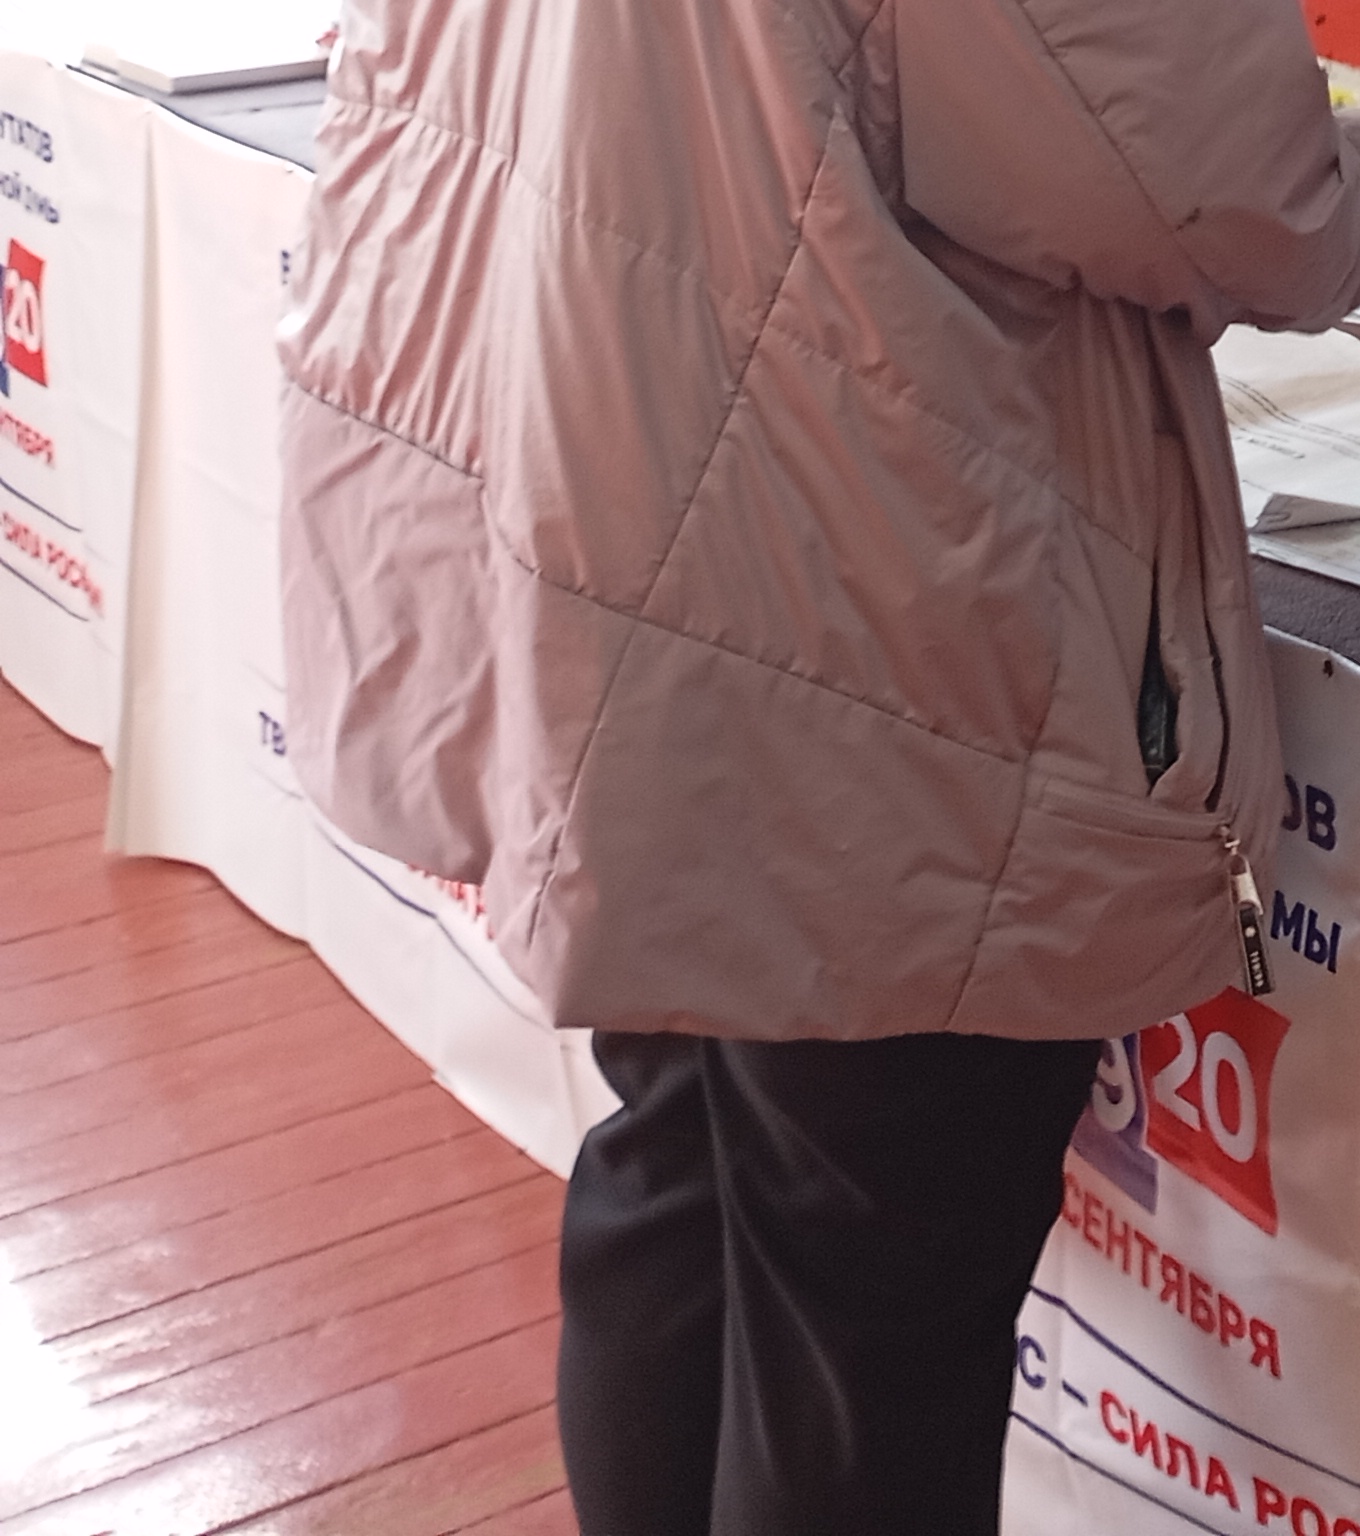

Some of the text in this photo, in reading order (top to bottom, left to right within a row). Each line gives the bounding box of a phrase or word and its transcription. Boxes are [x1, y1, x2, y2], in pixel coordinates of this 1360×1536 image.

[1270, 890, 1342, 974] МЫ
[1153, 1012, 1258, 1164] 20
[1062, 1172, 1282, 1380] СЕНТЯБРЯ
[1100, 1390, 1241, 1512] СИЛА
